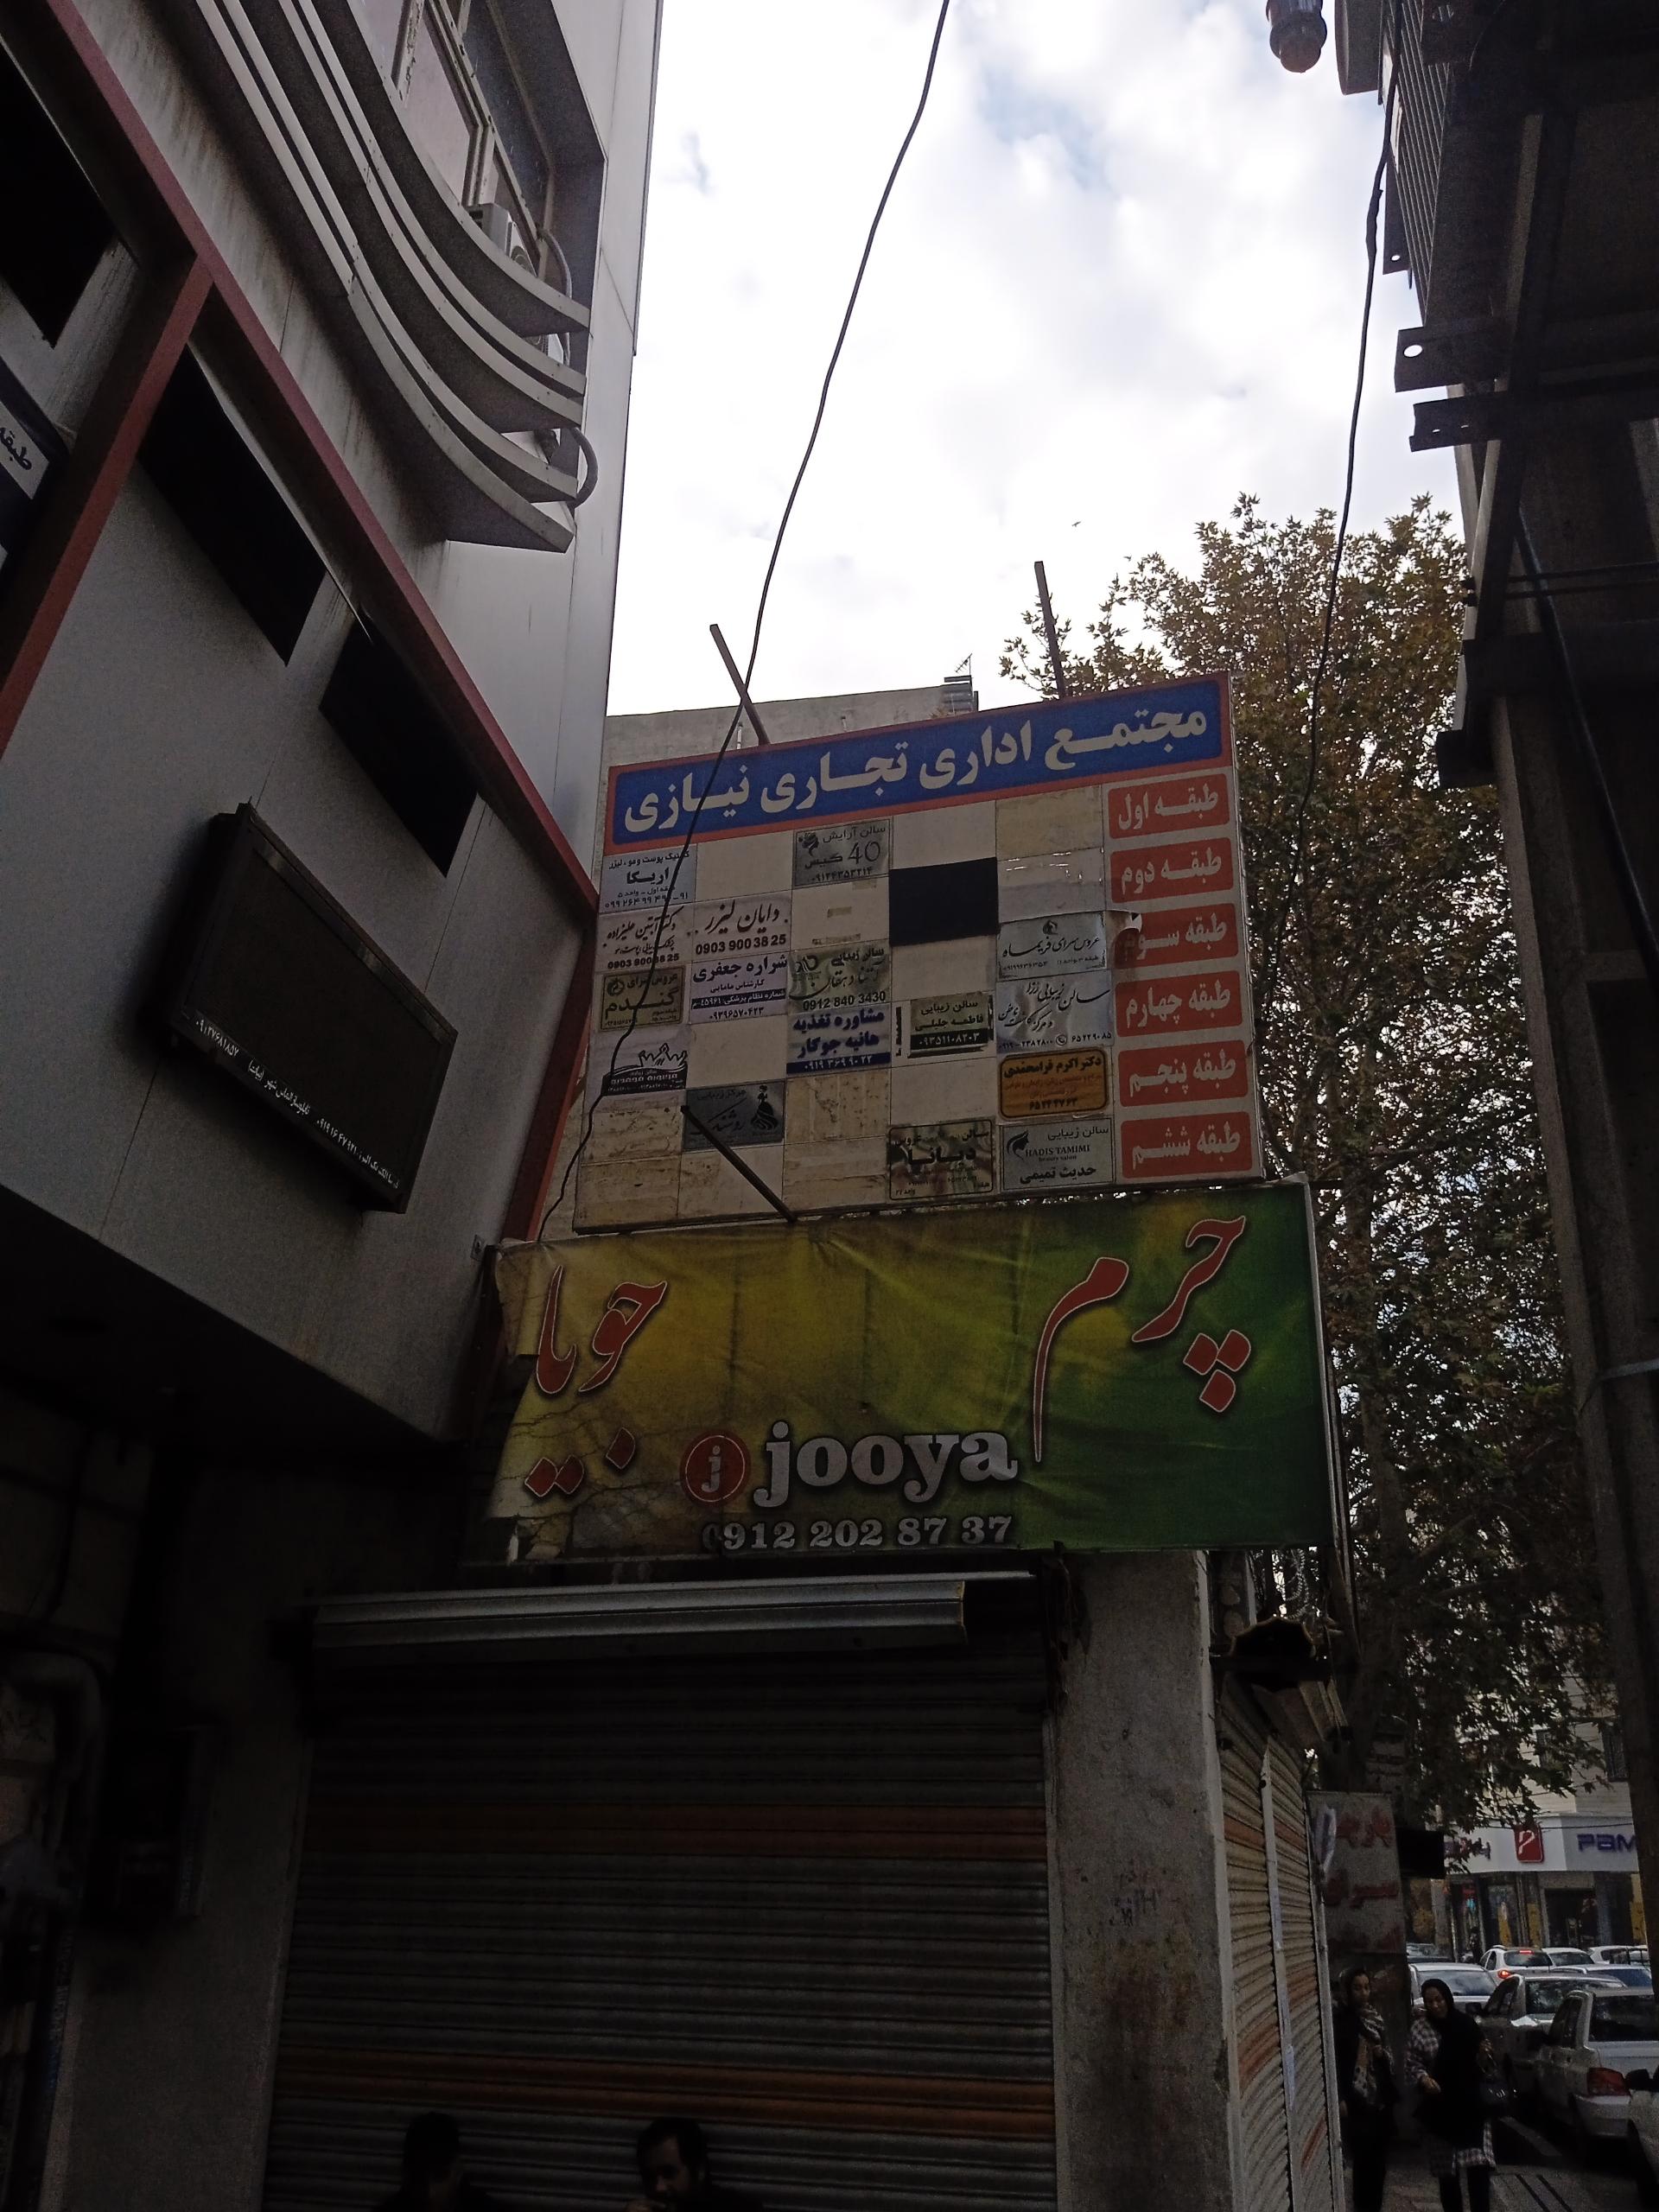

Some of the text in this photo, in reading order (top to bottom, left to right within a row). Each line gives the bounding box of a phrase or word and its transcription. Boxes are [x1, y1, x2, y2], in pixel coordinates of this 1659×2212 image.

[625, 709, 1206, 833] مجتمع اداری تجاری نیازی
[1118, 785, 1219, 830] طبقه اول
[823, 826, 886, 842] سالن آرایش
[848, 841, 880, 864] 40
[627, 867, 670, 885] اریکا
[1121, 847, 1222, 894] طبقه دوم
[704, 899, 735, 933] لیزر
[696, 934, 786, 955] 0903 900 38 25
[1185, 912, 1227, 950] طبقه
[607, 959, 632, 969] 0903
[693, 962, 741, 983] جعفری
[747, 954, 788, 976] شراره
[803, 990, 887, 1011] 0912 840 3430
[921, 1001, 978, 1015] سالن زیبایی
[1125, 979, 1231, 1027] طبقه چهارم
[793, 1007, 885, 1034] مشاوره تغذیه
[797, 1031, 880, 1059] هانیه جوکار
[1128, 1058, 1188, 1097] پنجم
[1192, 1050, 1236, 1089] طبقه
[1047, 1126, 1109, 1141] سالن زیبایی
[1131, 1122, 1241, 1168] طبقه ششم
[1026, 1145, 1090, 1158] HADIS TAMIMI
[1020, 1166, 1096, 1185] حدیث تمیمی
[523, 1214, 1252, 1497] چرم جویا
[753, 1420, 1018, 1508] jooya
[702, 1516, 1014, 1551] 0912 202 87 37
